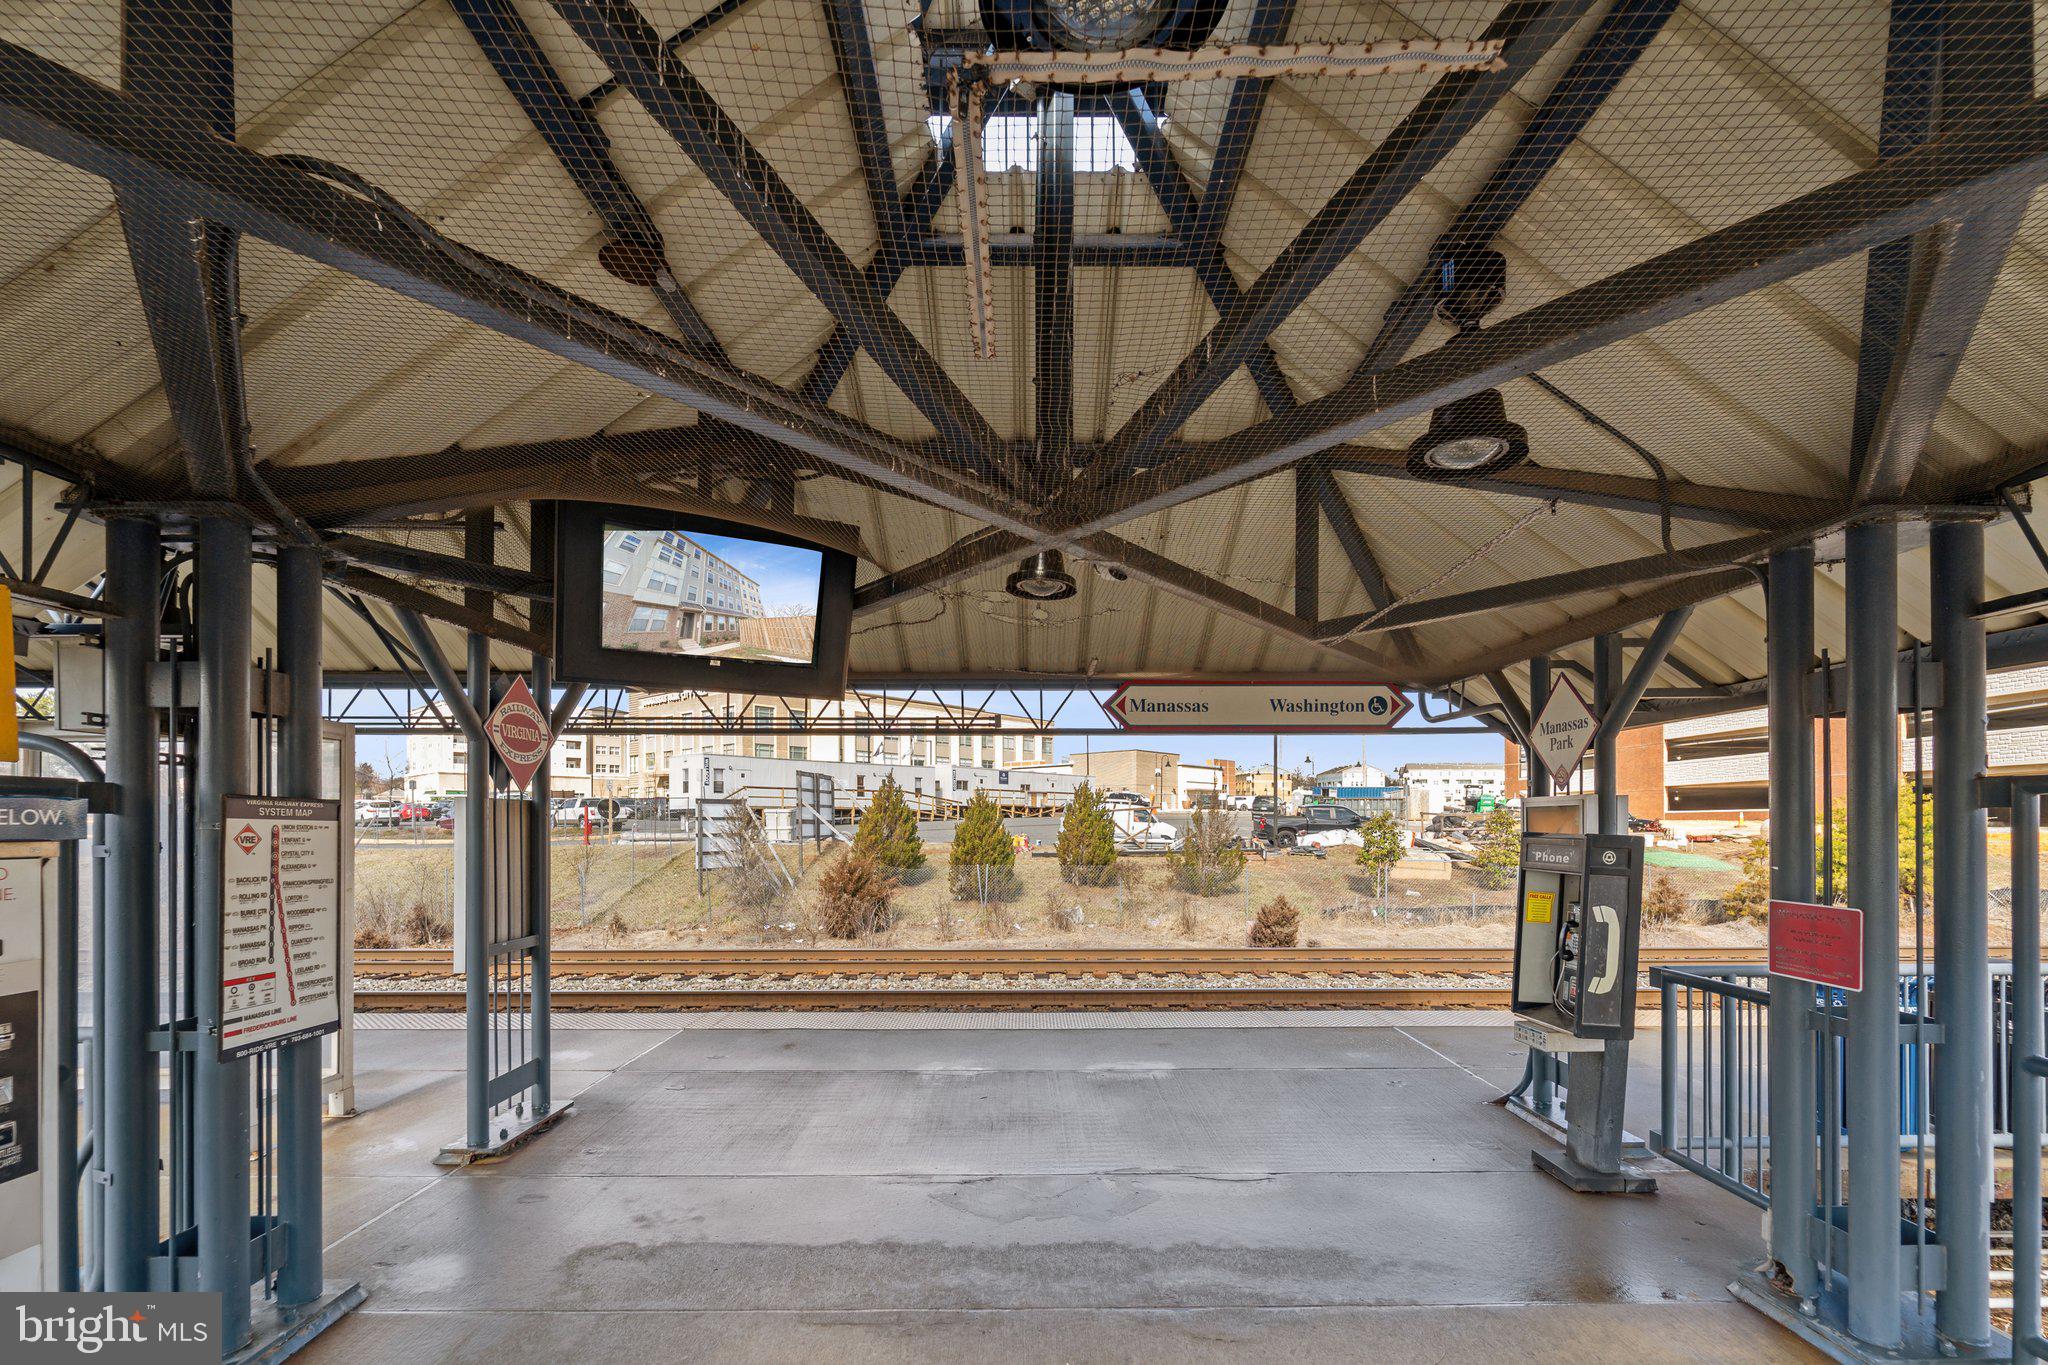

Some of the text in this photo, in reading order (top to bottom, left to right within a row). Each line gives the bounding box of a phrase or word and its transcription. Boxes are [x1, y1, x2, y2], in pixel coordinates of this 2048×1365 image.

[500, 704, 542, 723] RAILWAY
[1129, 698, 1365, 717] Manassas Washington
[501, 723, 540, 742] VIRGINIA
[1540, 717, 1589, 736] Manassas
[499, 742, 543, 762] EXPRESS
[1550, 735, 1574, 752] Park
[259, 807, 313, 817] SYSTEM MAP
[239, 835, 256, 844] VRE
[1535, 851, 1570, 863] Phone
[232, 925, 260, 934] MANASSAS
[243, 1007, 282, 1022] MANASSAS LINE
[243, 1015, 298, 1034] FREDERICKSBURG LINE
[236, 1041, 278, 1058] 800-RIDE-VRE
